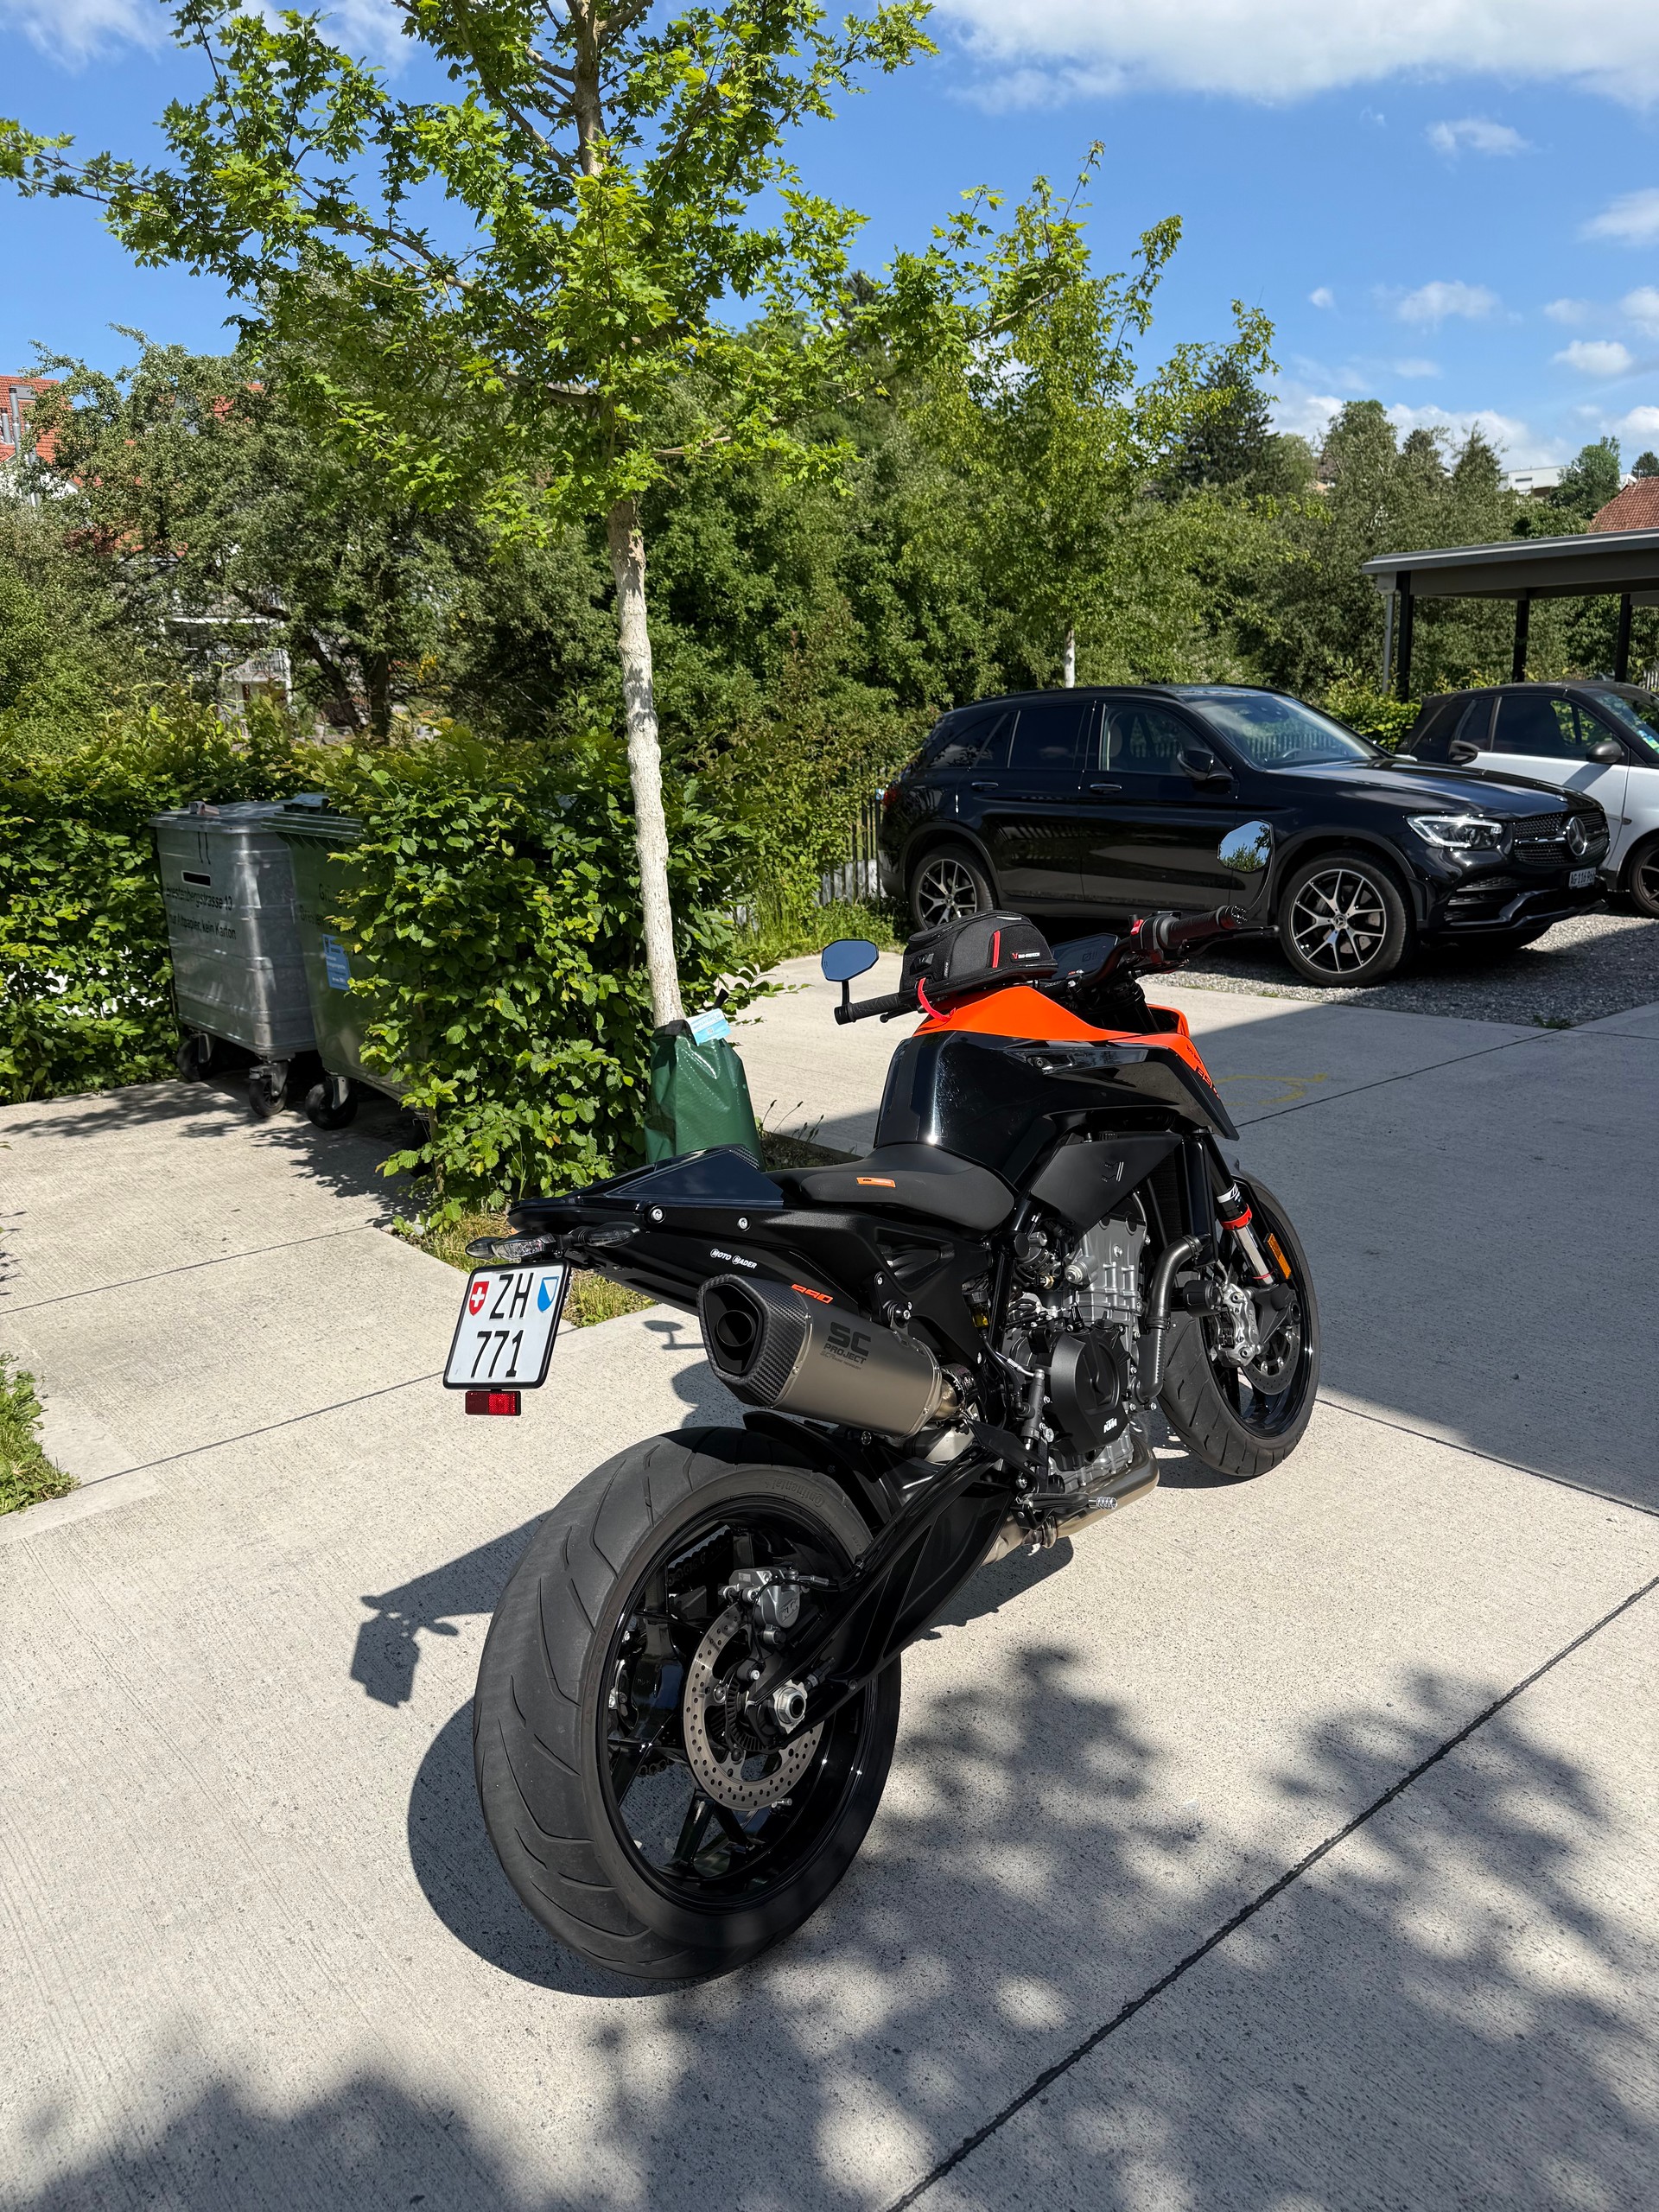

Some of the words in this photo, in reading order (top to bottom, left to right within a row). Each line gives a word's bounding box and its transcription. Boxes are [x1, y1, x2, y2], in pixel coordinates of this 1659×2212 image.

[214, 922, 237, 940] Karton
[709, 1248, 732, 1261] MOTO
[732, 1255, 758, 1269] MADER
[489, 1272, 534, 1319] ZH
[791, 1284, 834, 1304] 990
[827, 1321, 872, 1357] SC
[470, 1329, 524, 1378] 771
[823, 1343, 868, 1364] PROJECT
[1103, 1417, 1118, 1433] KTM
[772, 1478, 825, 1508] Continental
